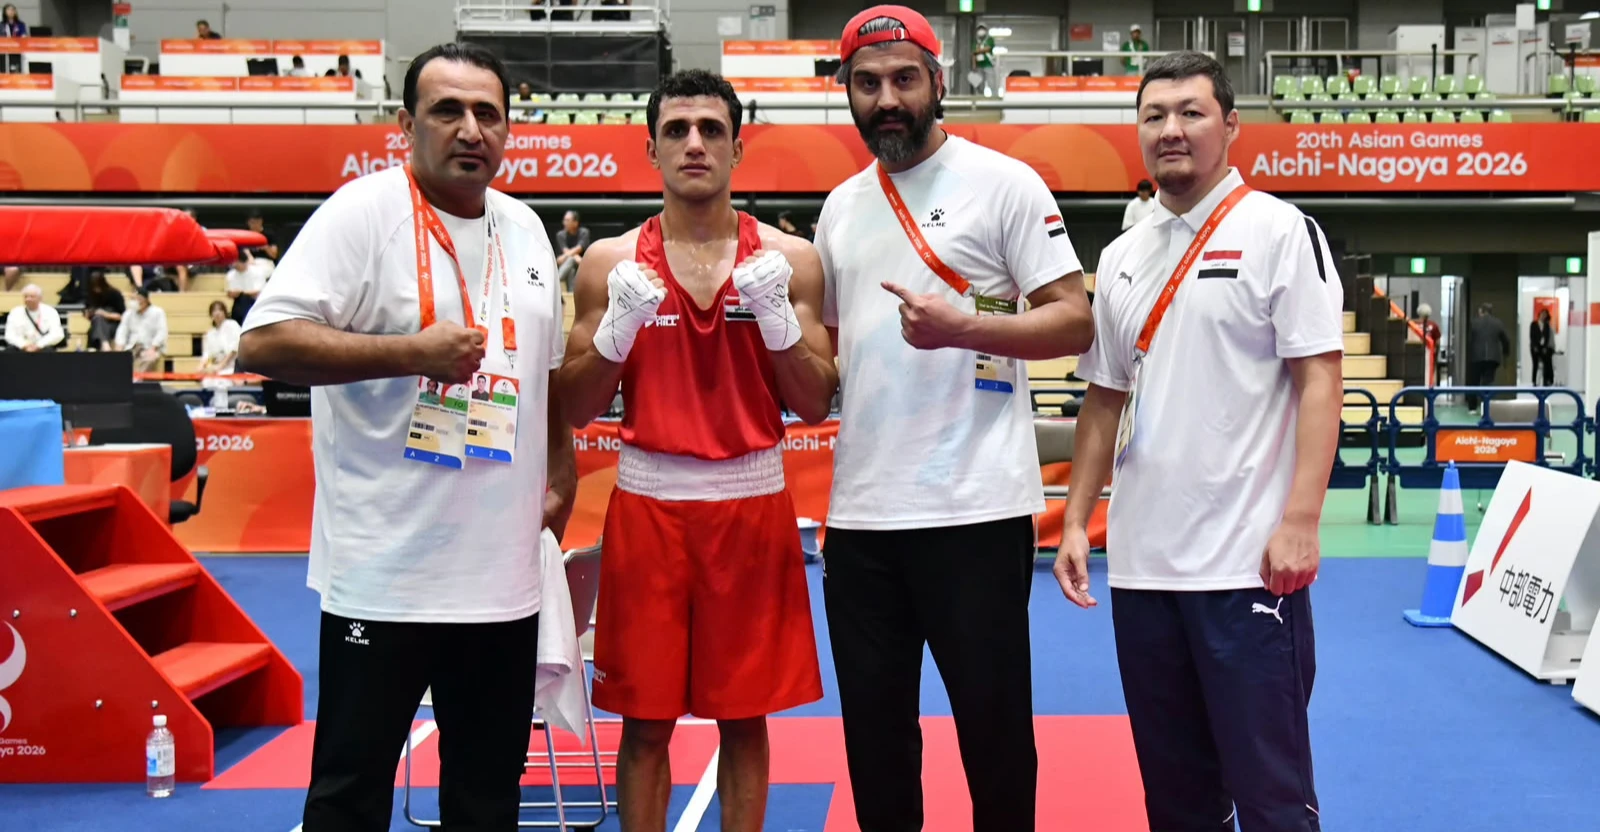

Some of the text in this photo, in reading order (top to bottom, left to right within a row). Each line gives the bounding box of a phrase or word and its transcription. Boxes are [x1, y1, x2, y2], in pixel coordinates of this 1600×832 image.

[1296, 132, 1482, 148] 20th Asian Games
[546, 153, 618, 178] 2026
[1250, 151, 1528, 183] Aichi-Nagoya 2026
[207, 435, 254, 451] 2026
[1455, 436, 1517, 447] Aichi-Nagoya
[1474, 446, 1498, 454] 2026
[1500, 565, 1554, 624] 中部電力
[345, 636, 370, 646] KELME
[17, 745, 46, 755] 2026
